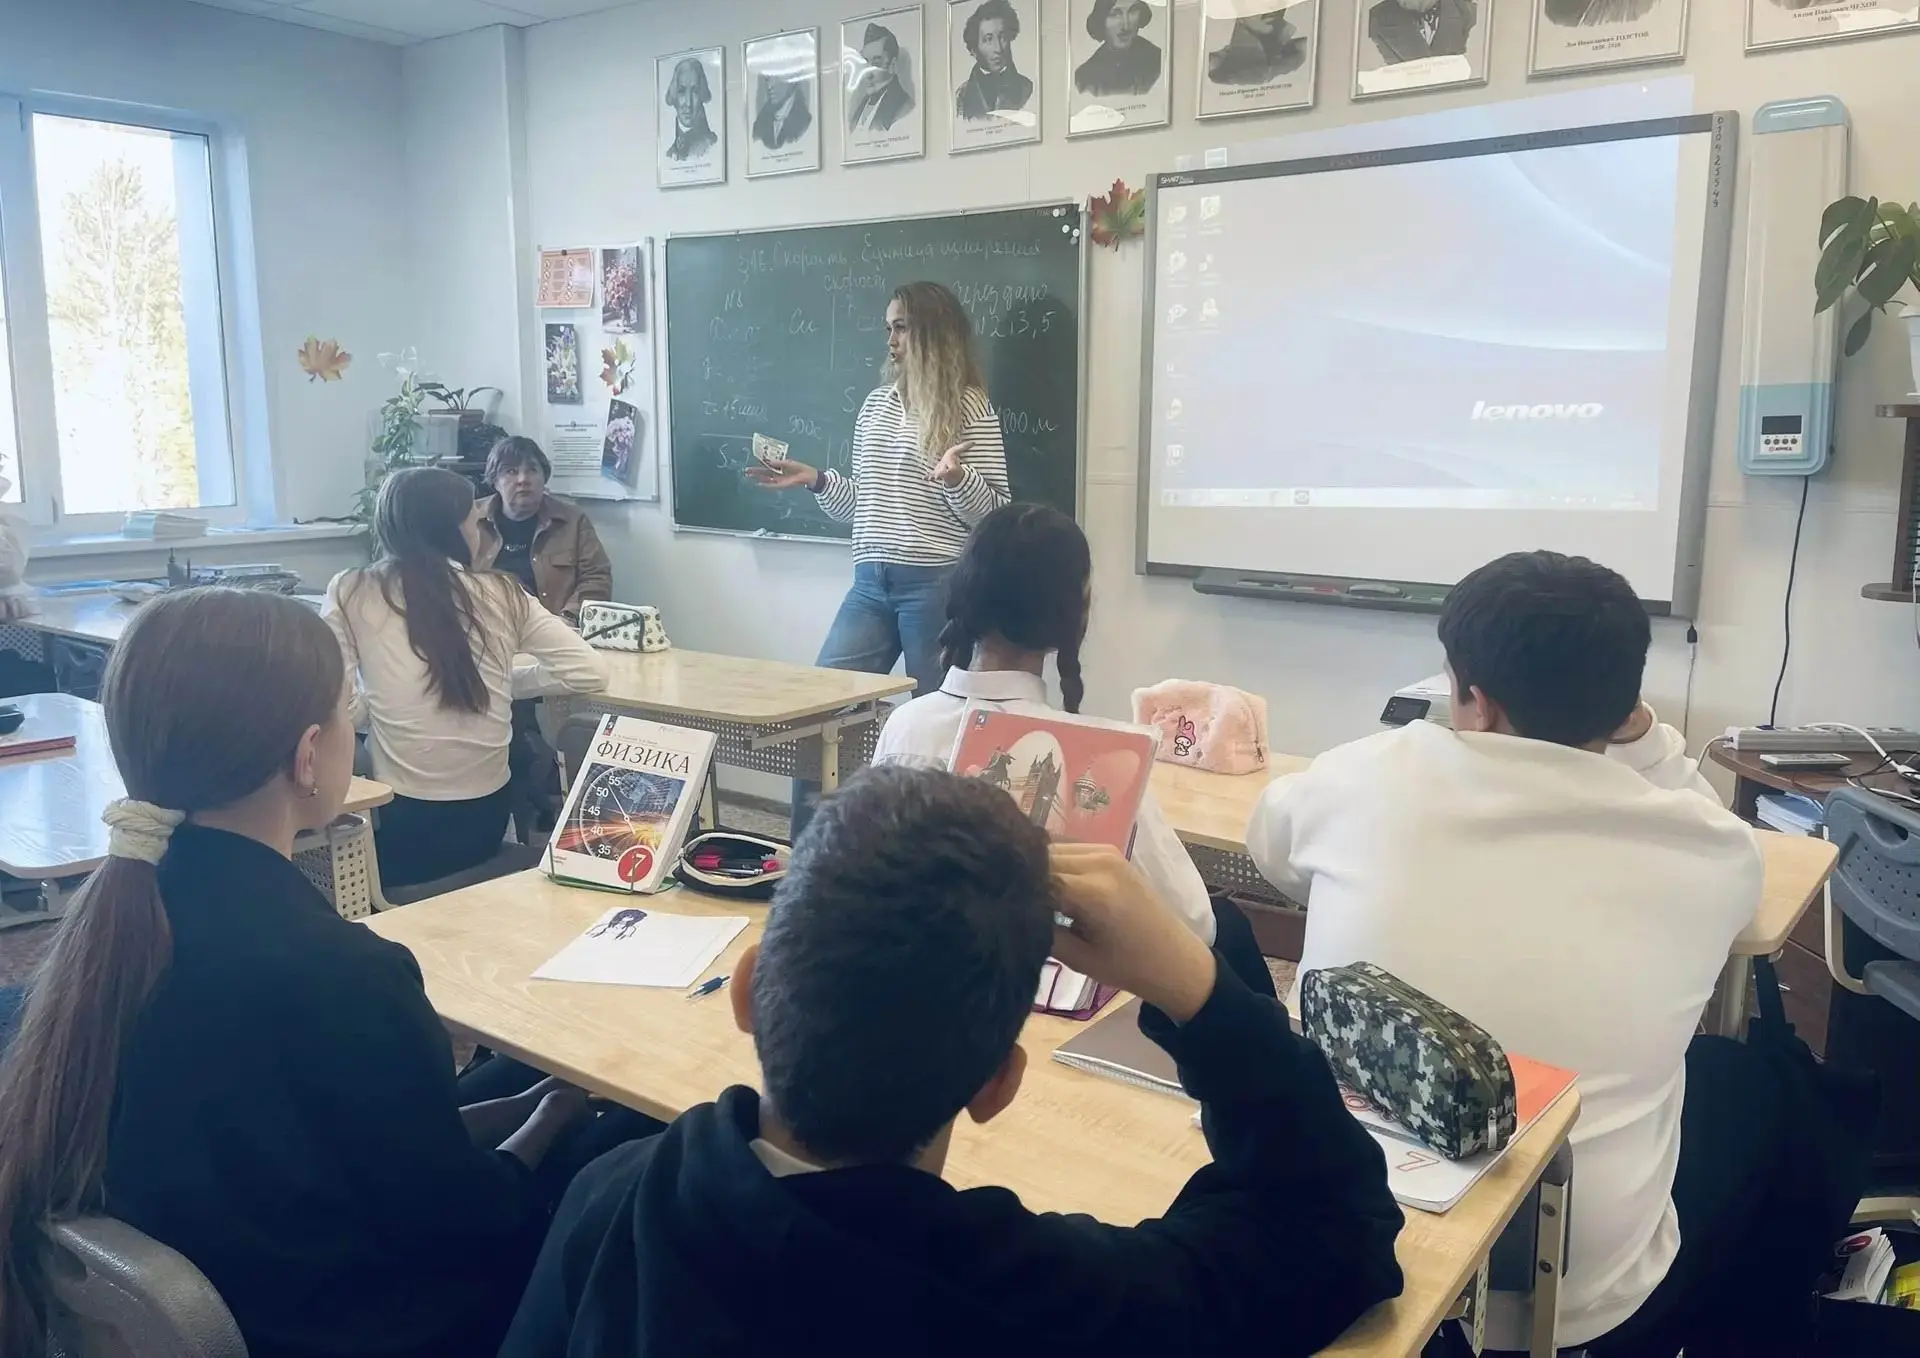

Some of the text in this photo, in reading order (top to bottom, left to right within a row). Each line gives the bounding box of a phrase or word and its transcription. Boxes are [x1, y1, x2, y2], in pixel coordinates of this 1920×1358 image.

[1470, 400, 1604, 421] lenovo
[597, 740, 690, 774] ФИЗИКА
[608, 775, 621, 787] 55
[596, 787, 609, 798] 50
[587, 805, 600, 816] 45
[590, 825, 604, 837] 40
[597, 843, 612, 855] 35
[626, 853, 647, 877] 7
